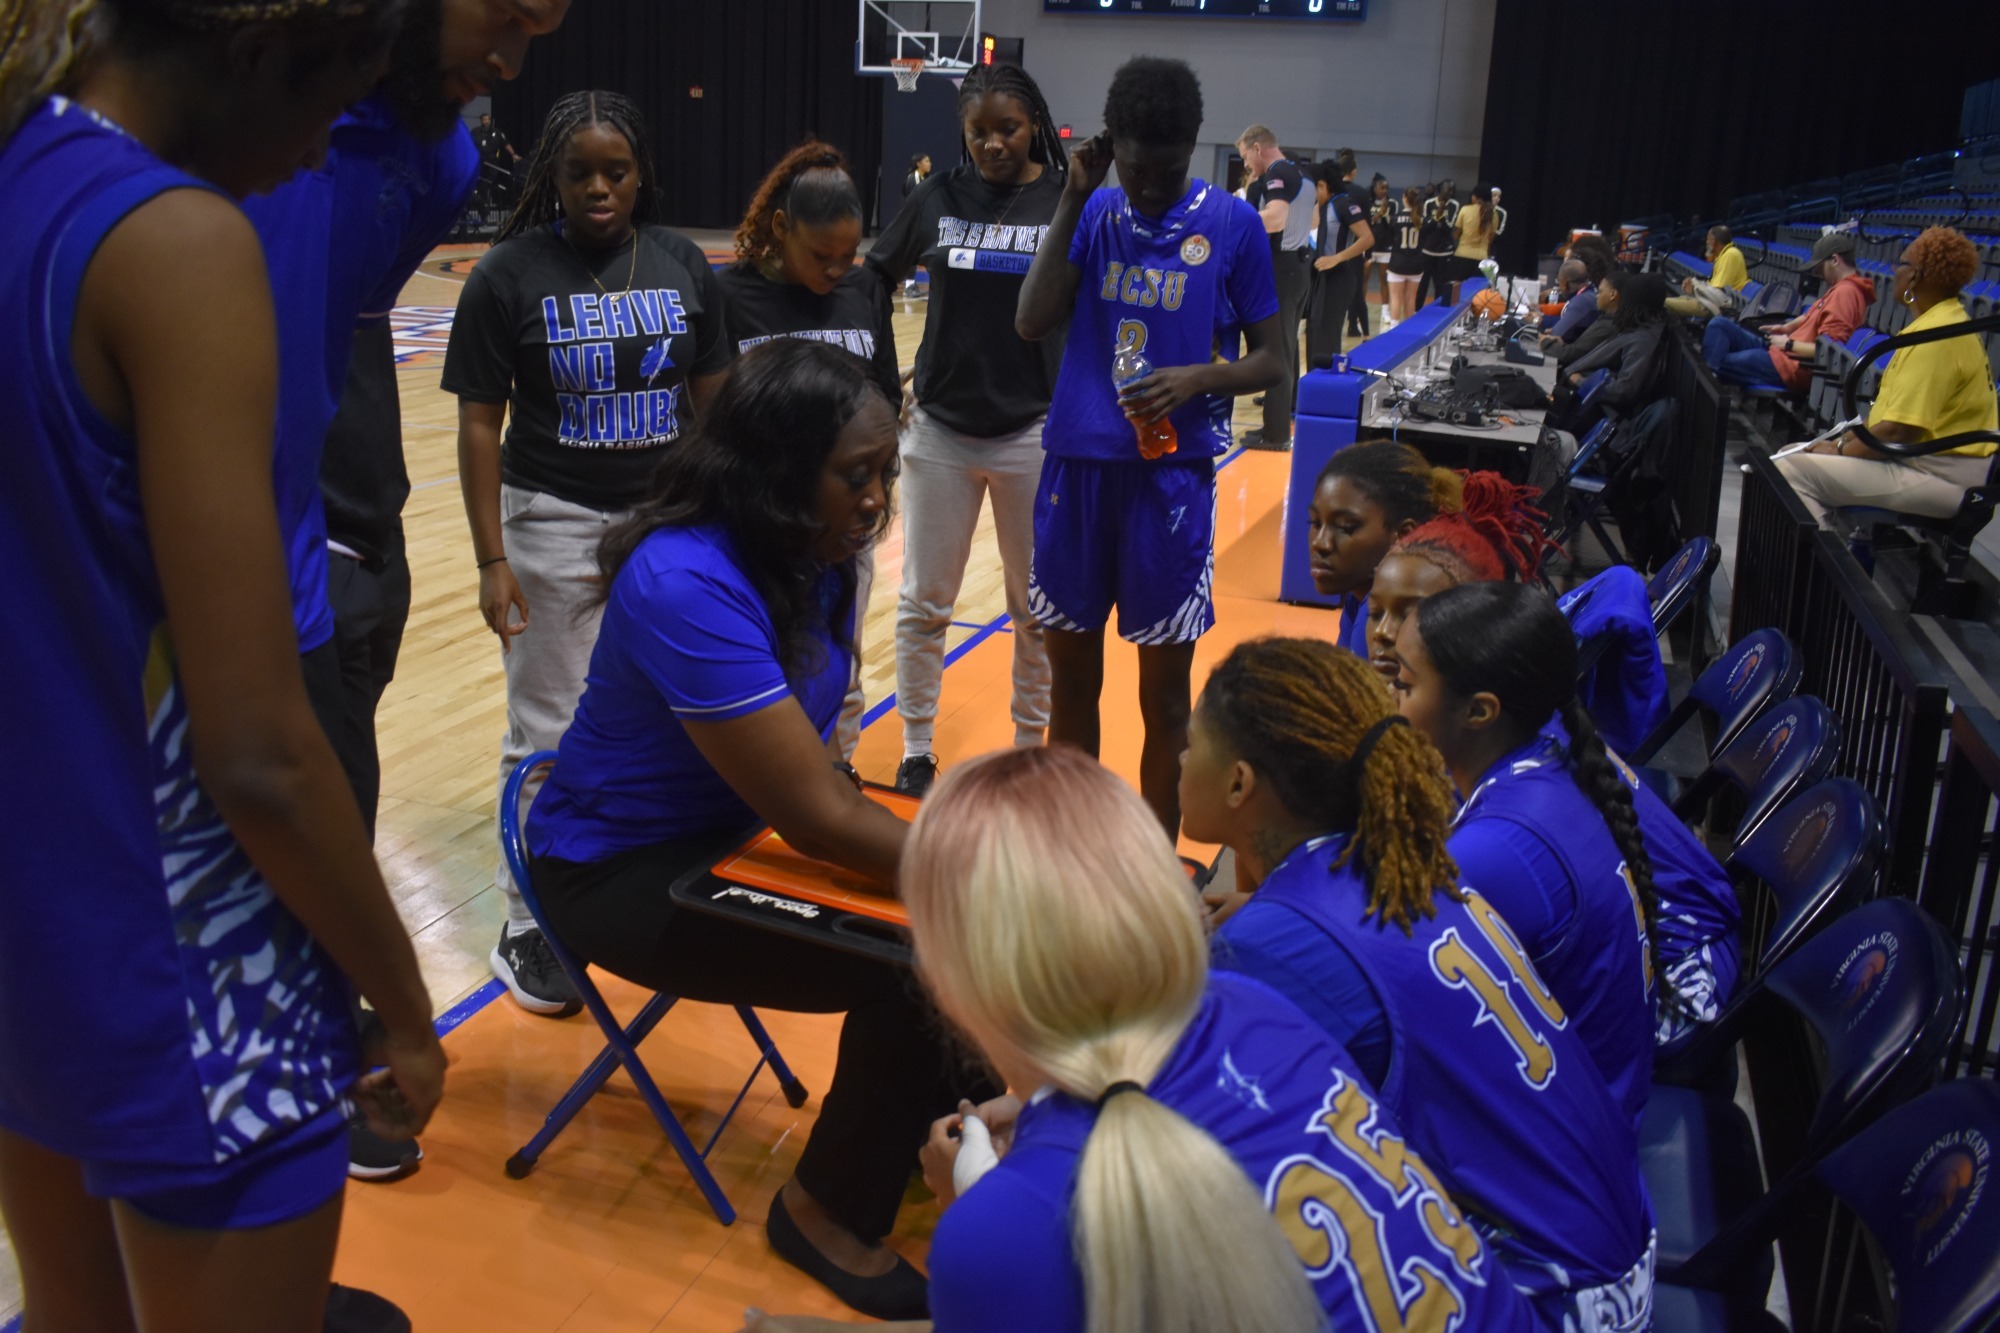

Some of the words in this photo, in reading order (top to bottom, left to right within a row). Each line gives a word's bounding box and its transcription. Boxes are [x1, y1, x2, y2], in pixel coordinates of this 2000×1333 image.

[937, 216, 968, 247] THIS
[964, 222, 984, 247] IS
[980, 223, 1015, 250] HOW
[1014, 225, 1038, 252] WE
[1185, 244, 1205, 257] 50
[1401, 226, 1420, 249] 10
[979, 254, 1031, 272] BASKETBA
[1101, 261, 1189, 311] ECSU
[542, 288, 688, 343] LEAVE
[549, 341, 616, 392] NO
[556, 383, 683, 442] DOUBT
[604, 429, 680, 450] BASKETBALL
[1428, 886, 1568, 1091] 10
[1900, 1130, 1960, 1195] VIRGINIA
